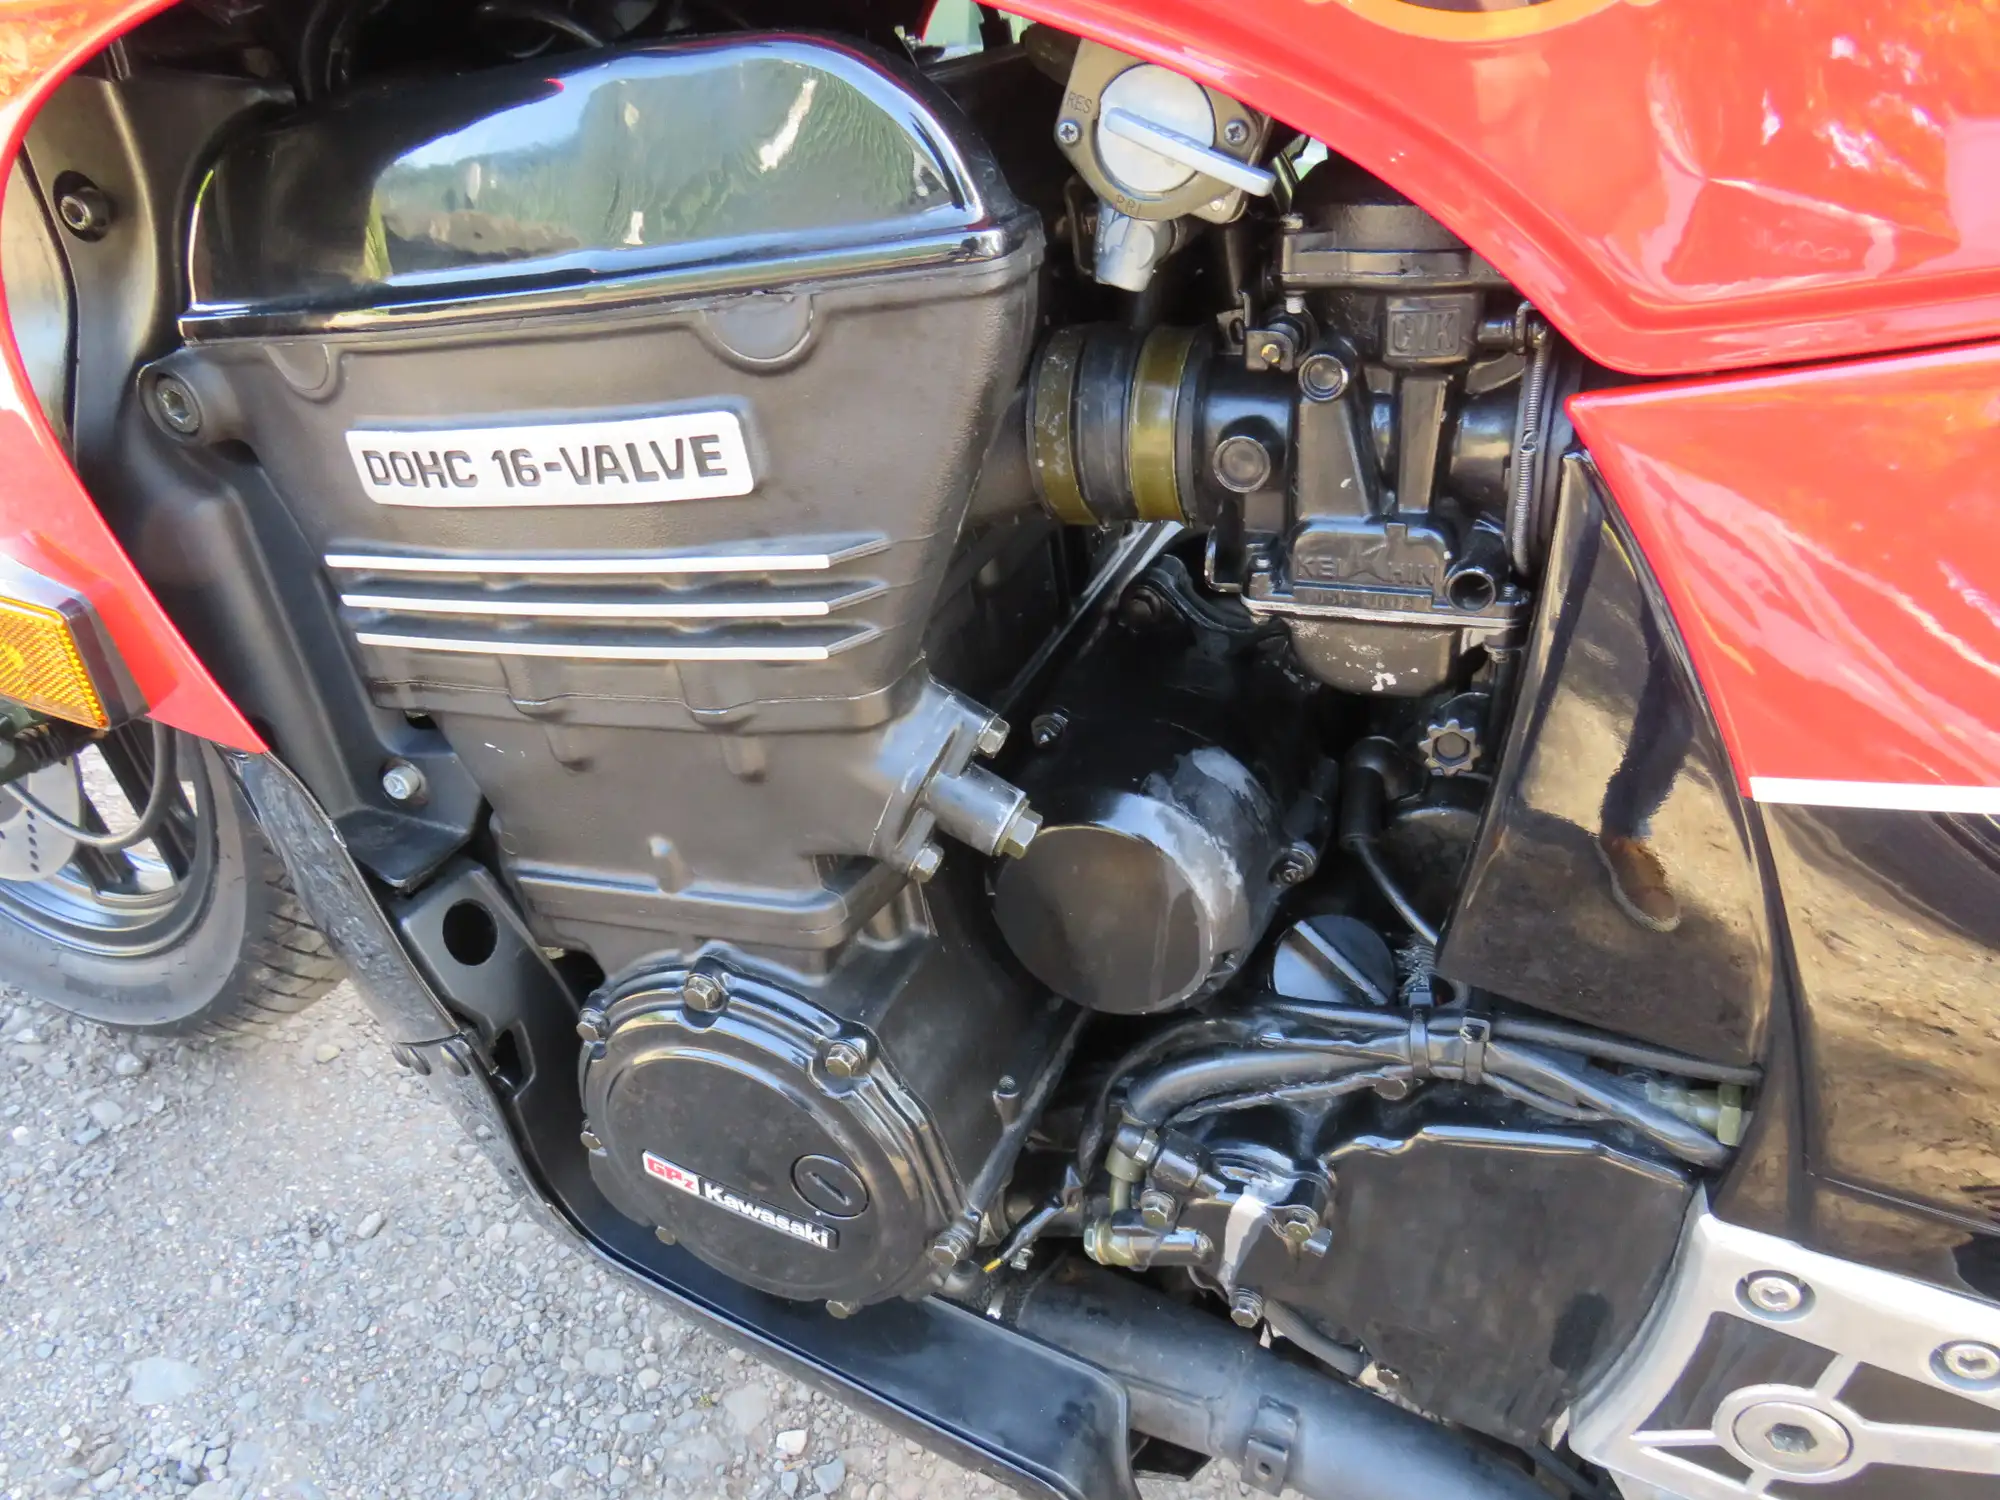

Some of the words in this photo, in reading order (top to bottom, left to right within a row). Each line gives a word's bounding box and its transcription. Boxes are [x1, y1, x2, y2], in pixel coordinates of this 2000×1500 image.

[1066, 91, 1093, 114] RES
[1117, 195, 1142, 217] PRI
[362, 450, 478, 488] DOHC
[491, 434, 728, 488] 16-VALVE
[704, 1181, 829, 1249] Kawasaki
